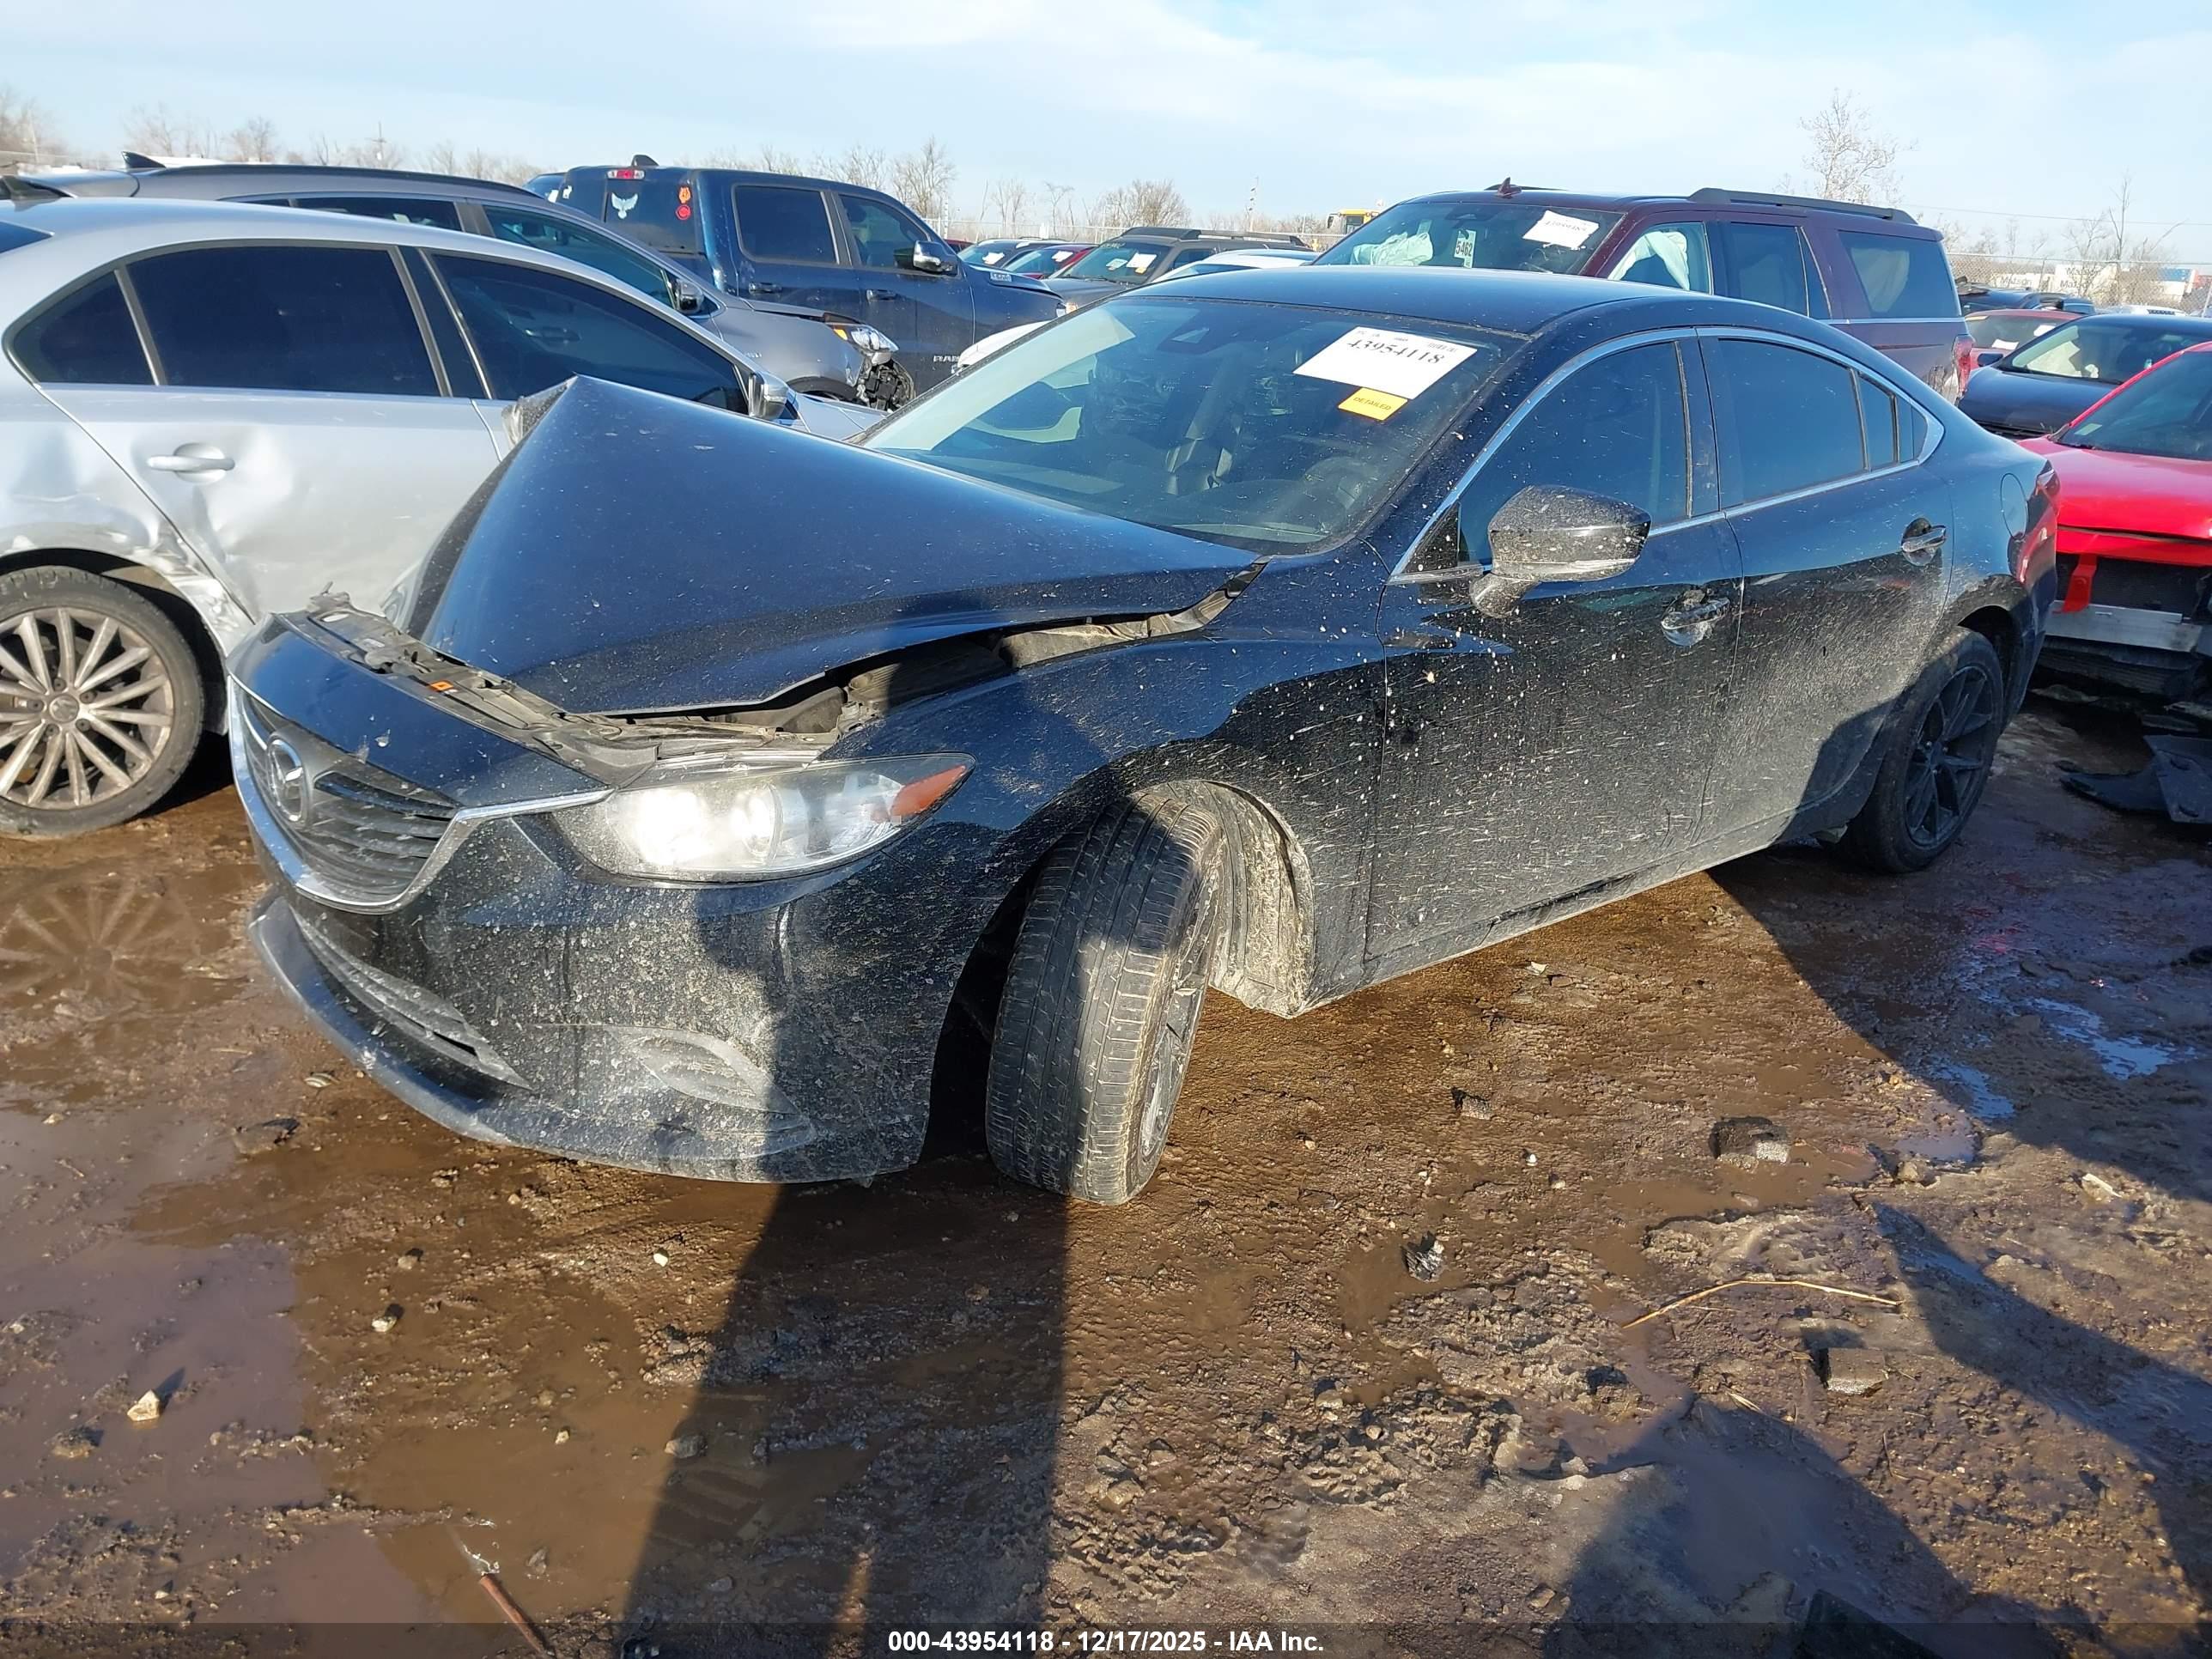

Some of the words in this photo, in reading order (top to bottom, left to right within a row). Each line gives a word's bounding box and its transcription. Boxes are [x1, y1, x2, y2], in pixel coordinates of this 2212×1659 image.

[1455, 240, 1473, 257] 5462
[1346, 339, 1444, 364] 43954118
[1352, 397, 1391, 411] DETAILED
